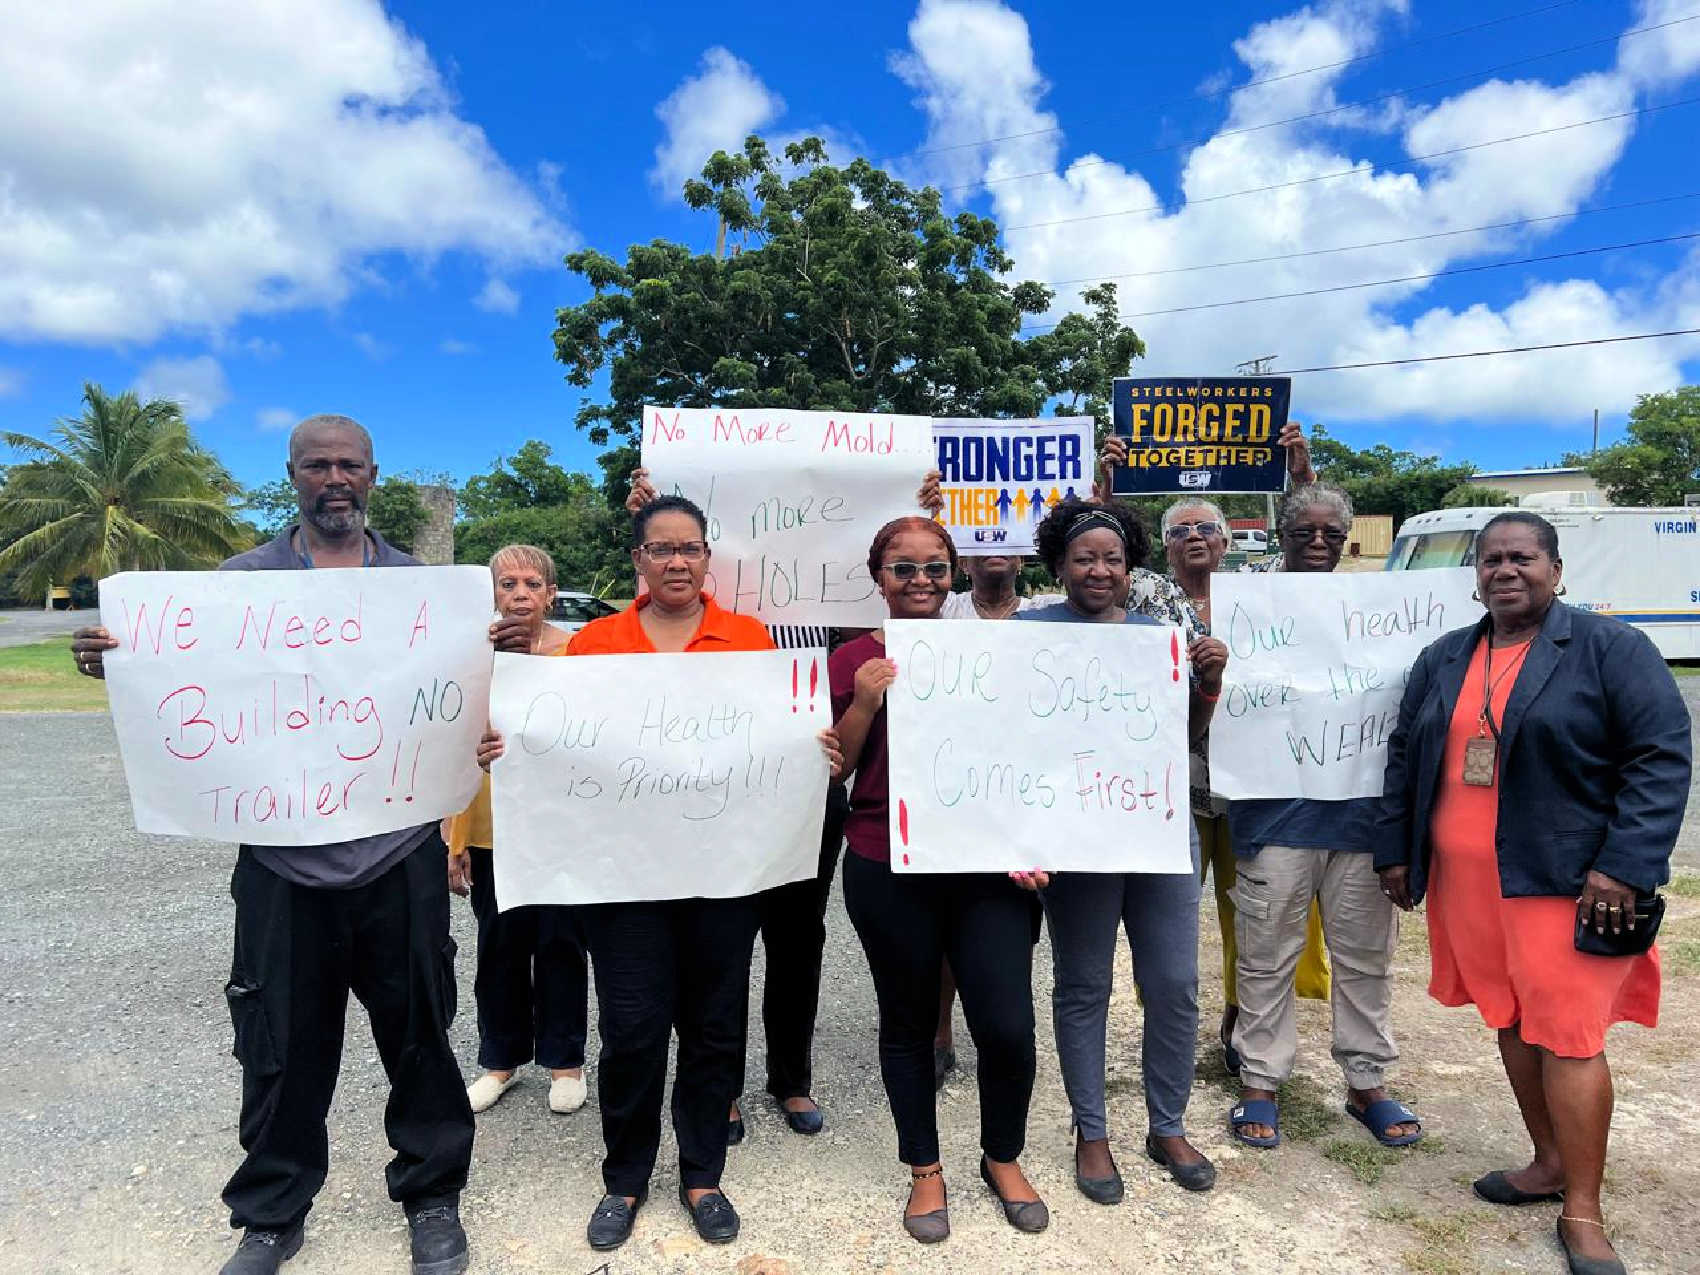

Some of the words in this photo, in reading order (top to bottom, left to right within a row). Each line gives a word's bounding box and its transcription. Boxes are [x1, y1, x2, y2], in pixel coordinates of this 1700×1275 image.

[1131, 387, 1272, 397] STEELWORKERS
[652, 412, 685, 445] No
[1132, 403, 1271, 443] FORGED
[933, 433, 1081, 482] RONGER
[975, 530, 1008, 542] USW
[1654, 521, 1697, 534] VIRGIN
[1342, 591, 1446, 642] health
[1690, 590, 1700, 603] S
[121, 594, 199, 656] We
[235, 592, 363, 650] Need
[408, 599, 431, 649] A
[1028, 648, 1158, 742] Safety
[1328, 662, 1385, 703] the
[157, 673, 385, 761] Building
[409, 677, 463, 727] NO
[521, 691, 609, 756] Our
[638, 693, 755, 757] Health
[1286, 711, 1399, 767] WEAL
[567, 765, 604, 799] is
[933, 737, 1056, 809] Comes
